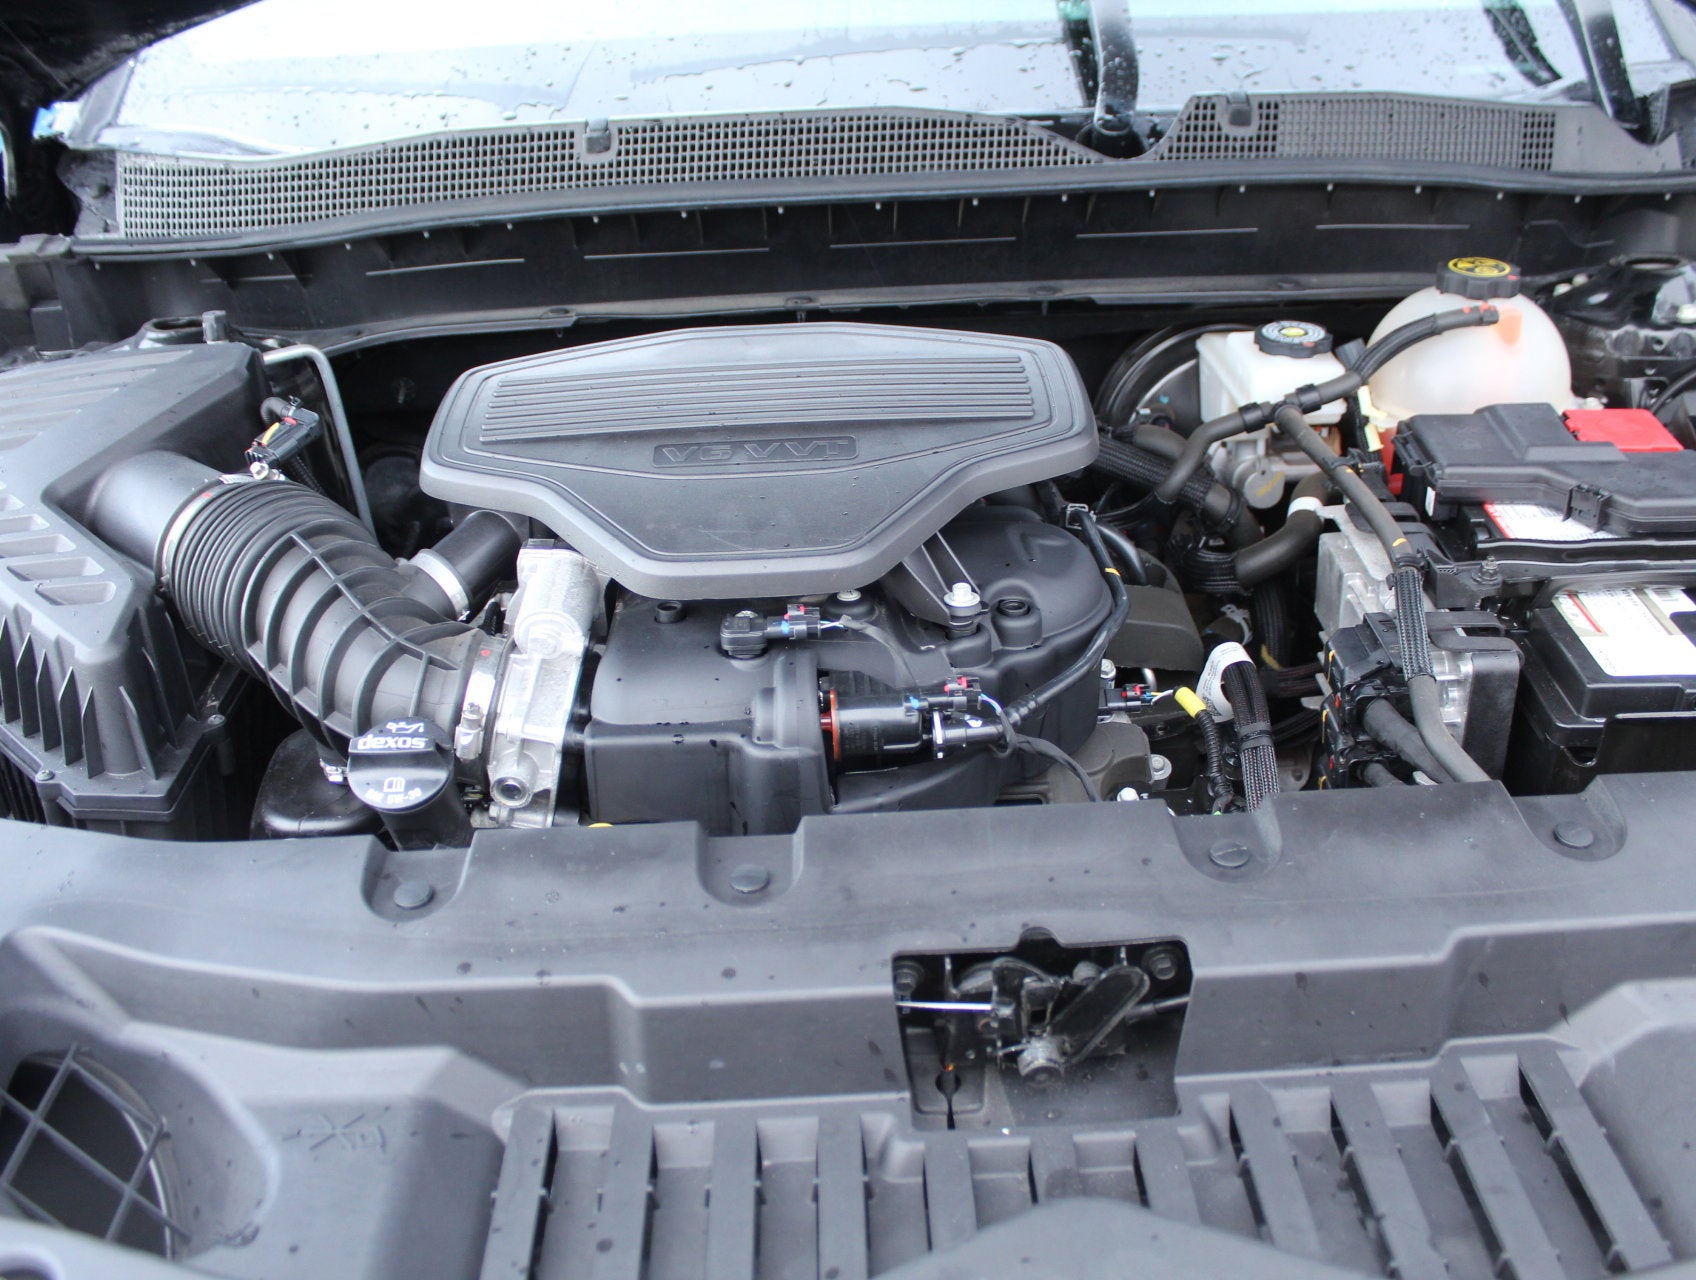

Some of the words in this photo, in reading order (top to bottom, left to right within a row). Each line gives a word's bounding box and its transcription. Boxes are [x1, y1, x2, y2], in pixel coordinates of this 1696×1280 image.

[662, 445, 733, 462] V6
[744, 440, 849, 459] VVT
[357, 734, 427, 750] dexos
